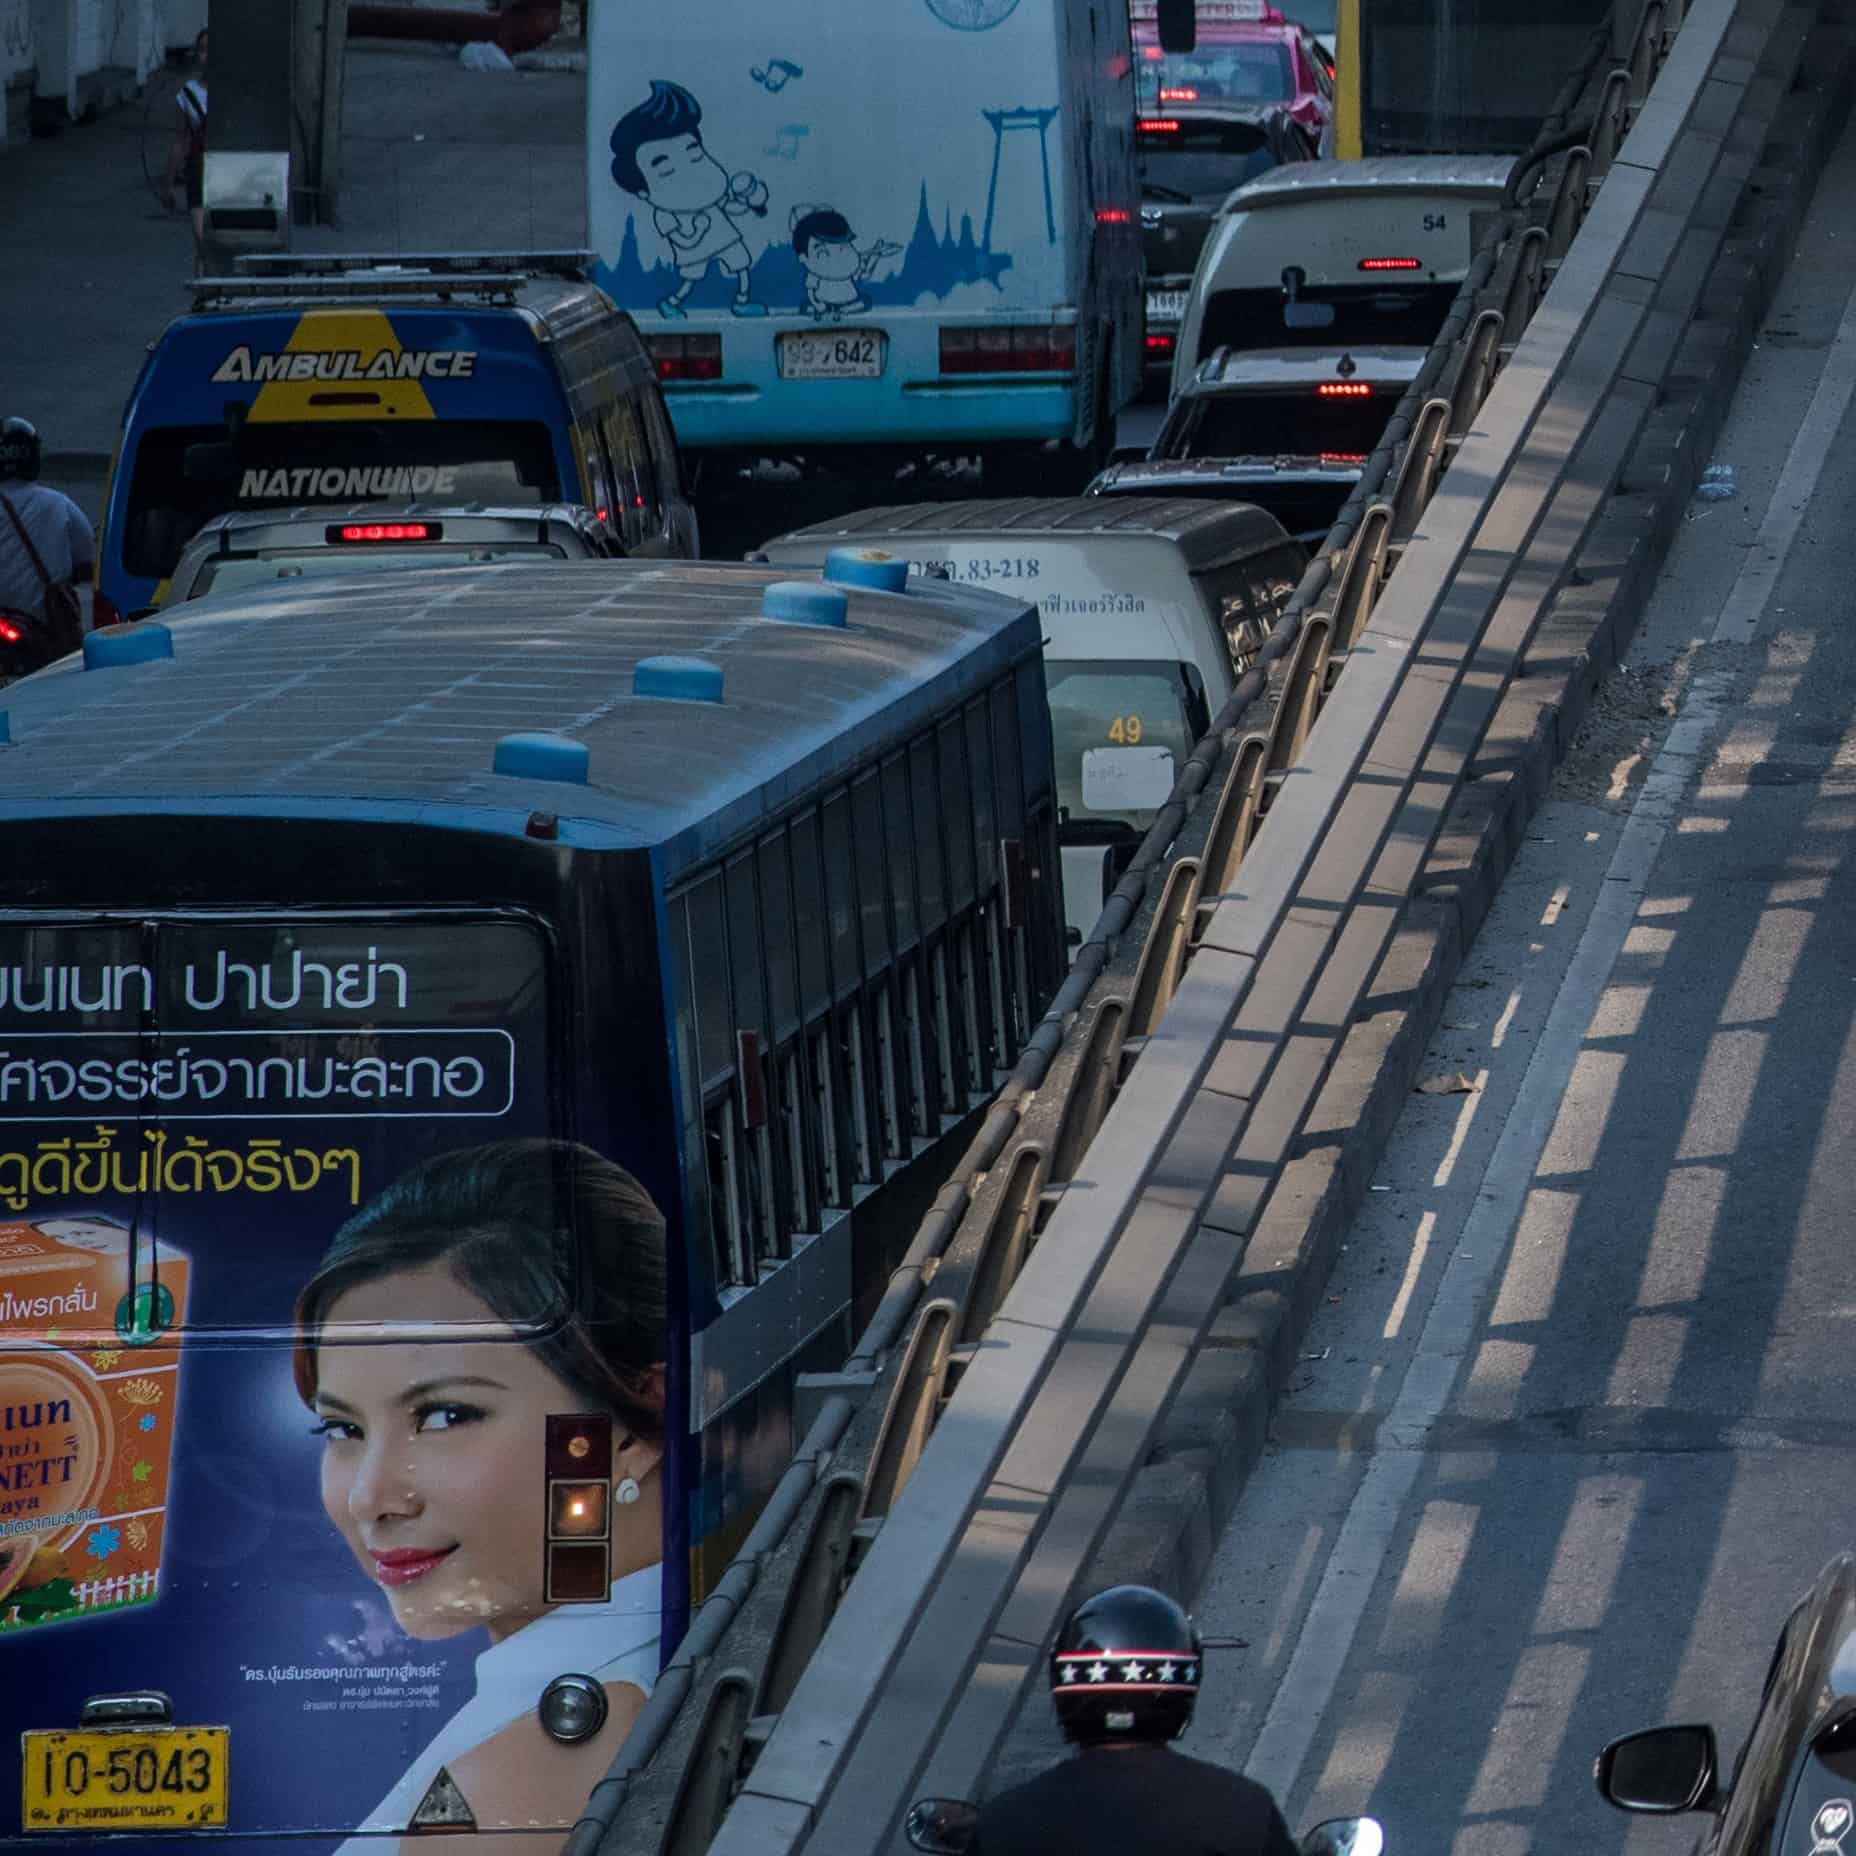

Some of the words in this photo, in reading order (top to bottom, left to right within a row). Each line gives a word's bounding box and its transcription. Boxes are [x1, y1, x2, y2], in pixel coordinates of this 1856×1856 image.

[1422, 215, 1447, 231] 54
[239, 465, 461, 498] NATIONWIDE
[1108, 717, 1142, 744] 49
[185, 947, 409, 1012] ปาปาย่า
